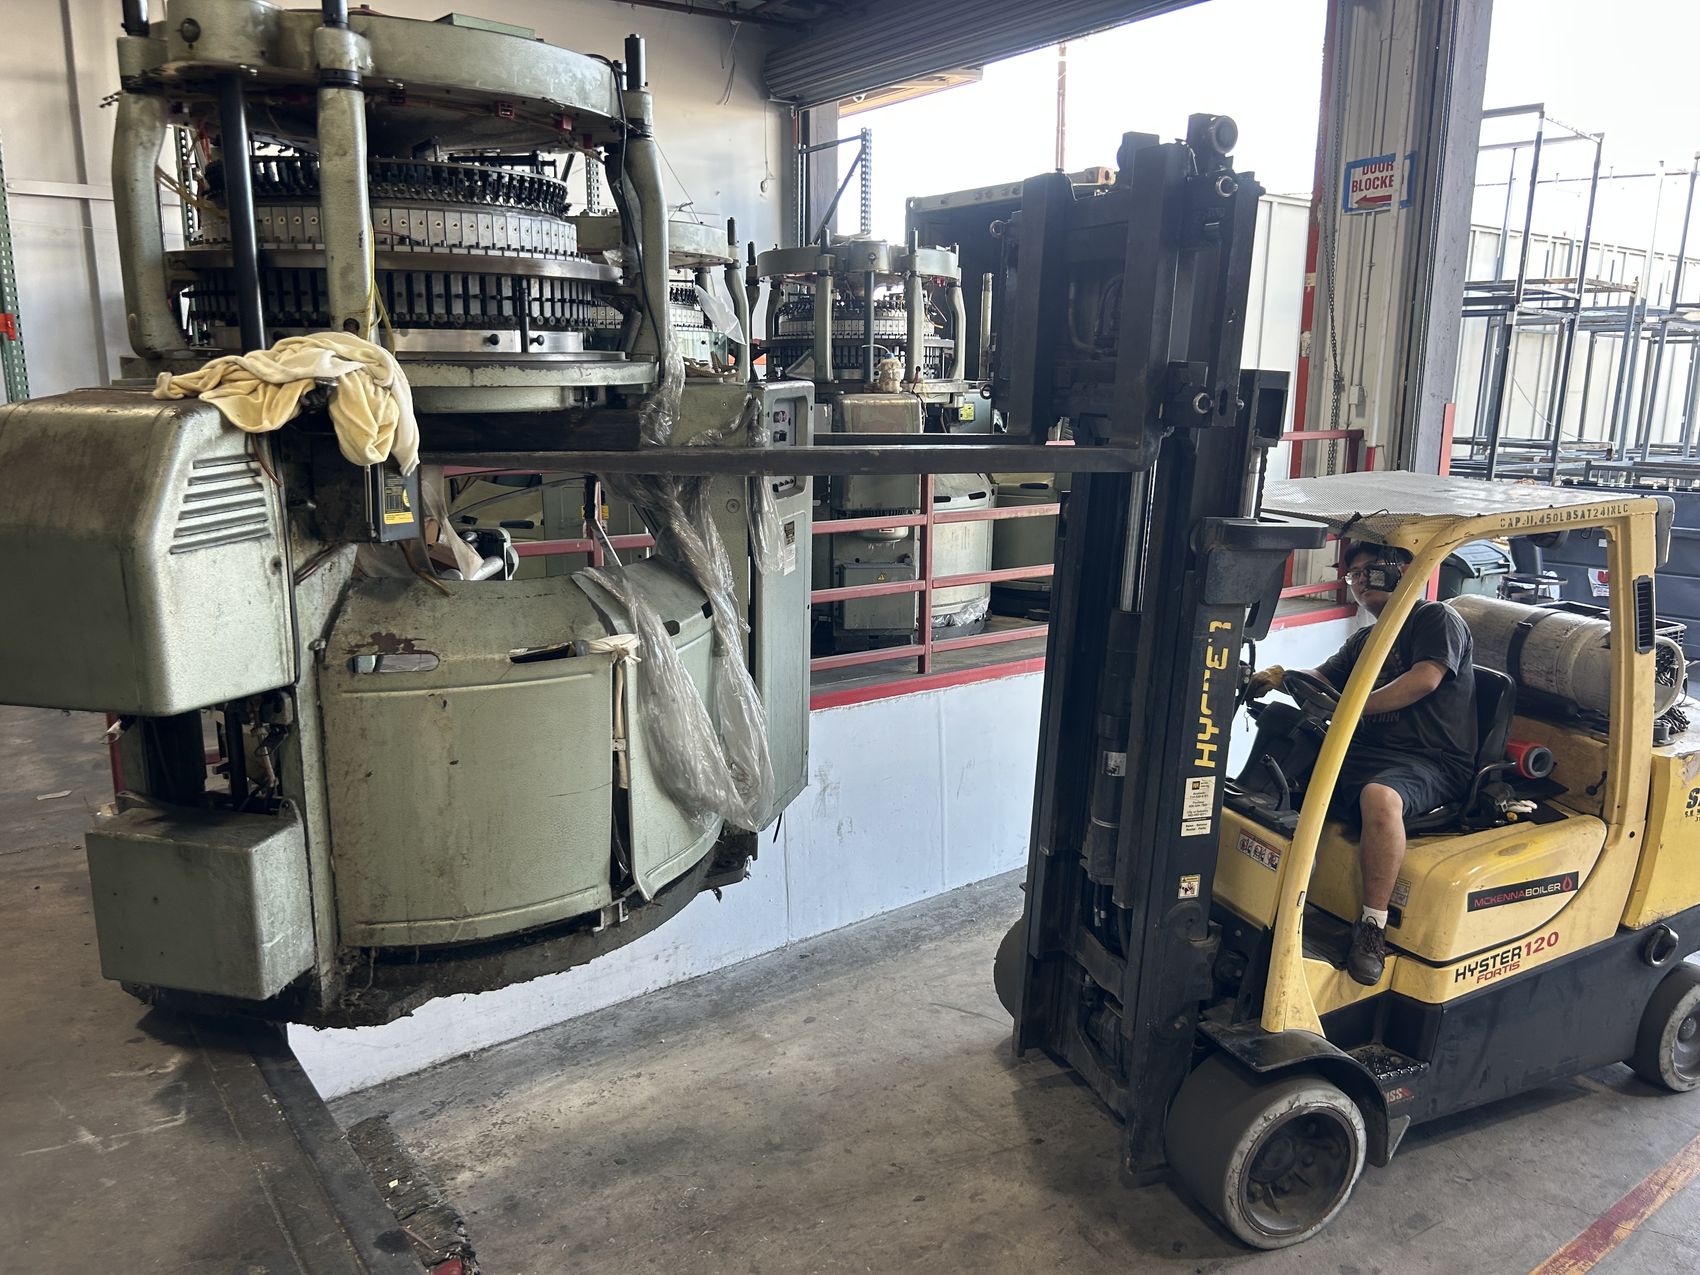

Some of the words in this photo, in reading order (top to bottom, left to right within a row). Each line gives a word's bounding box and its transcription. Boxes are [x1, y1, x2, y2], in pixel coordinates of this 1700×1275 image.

[1362, 161, 1394, 176] DOOR
[1351, 174, 1396, 193] BLOCKE
[1454, 945, 1522, 983] HYSTER
[1524, 931, 1560, 957] 120
[1476, 961, 1521, 984] FORTIS
